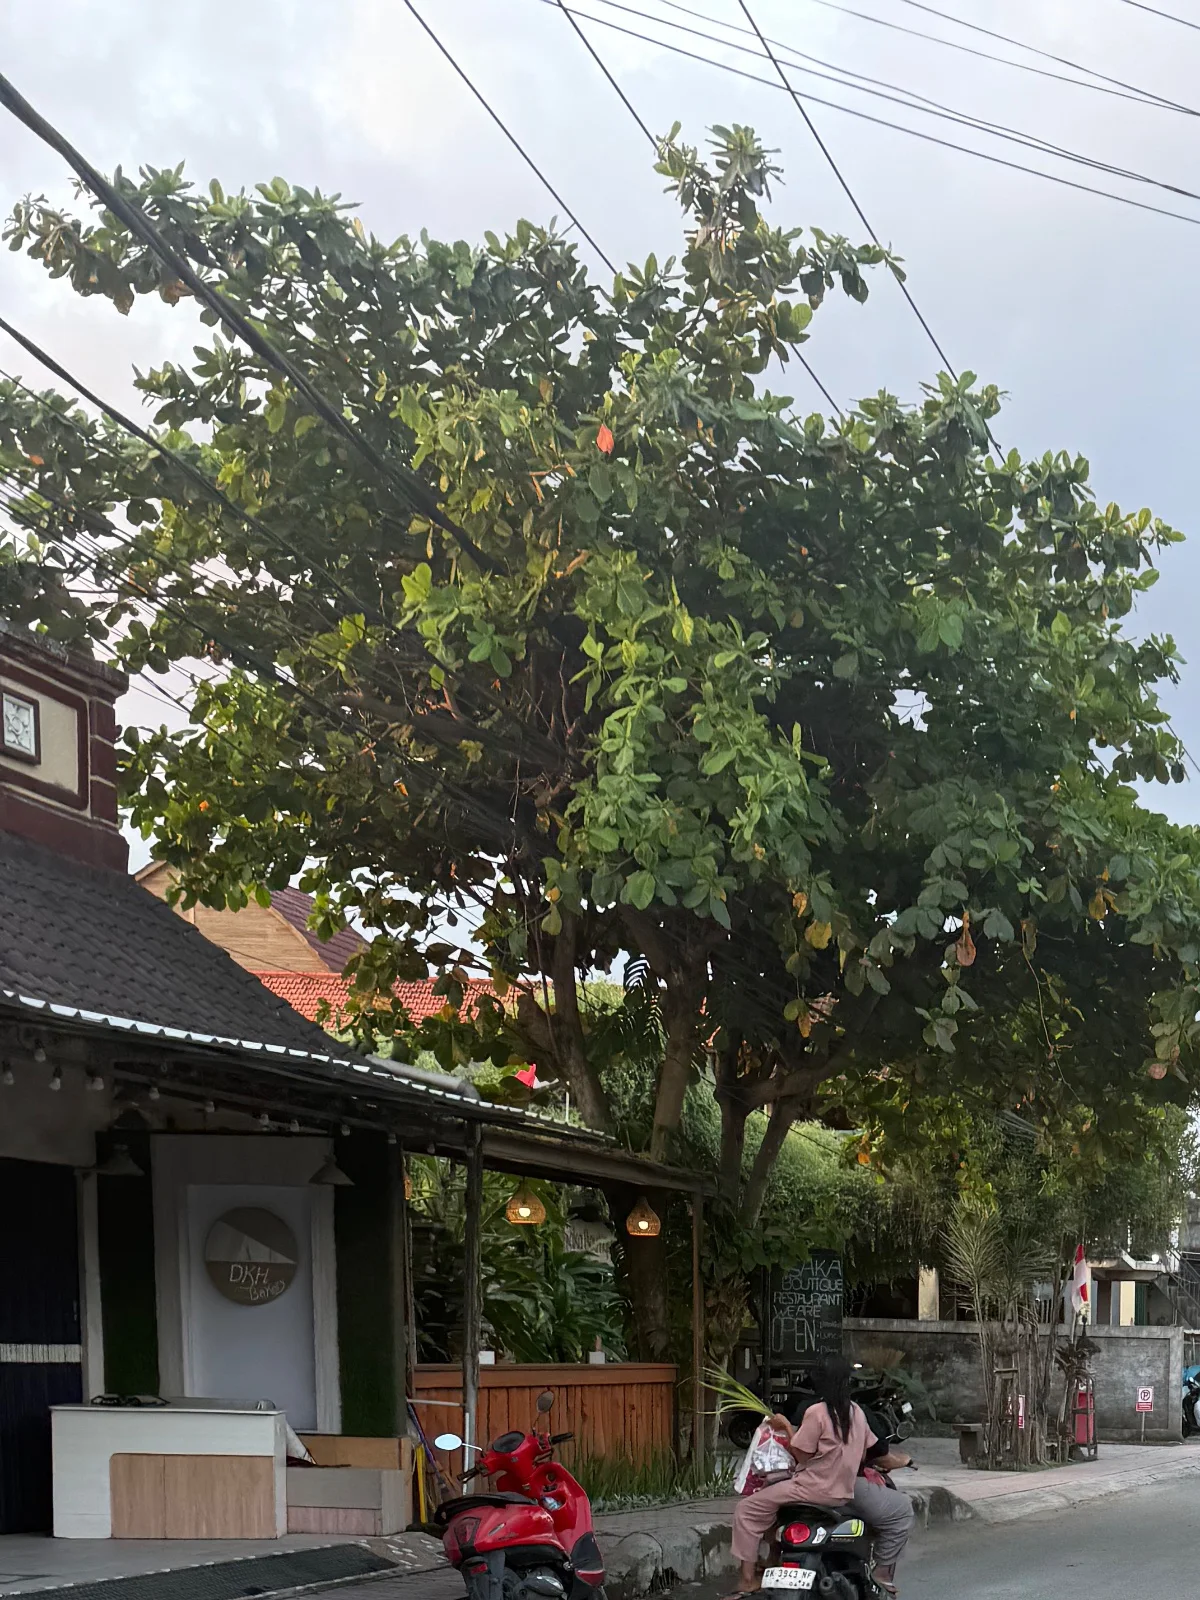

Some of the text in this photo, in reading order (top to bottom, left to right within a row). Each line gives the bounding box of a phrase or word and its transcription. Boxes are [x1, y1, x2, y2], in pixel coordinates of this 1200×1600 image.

[229, 1264, 269, 1285] DKH
[782, 1278, 843, 1292] BOUTIQUE
[773, 1292, 842, 1306] RESTAURANT
[796, 1305, 821, 1318] ARE
[772, 1317, 816, 1353] OPEN
